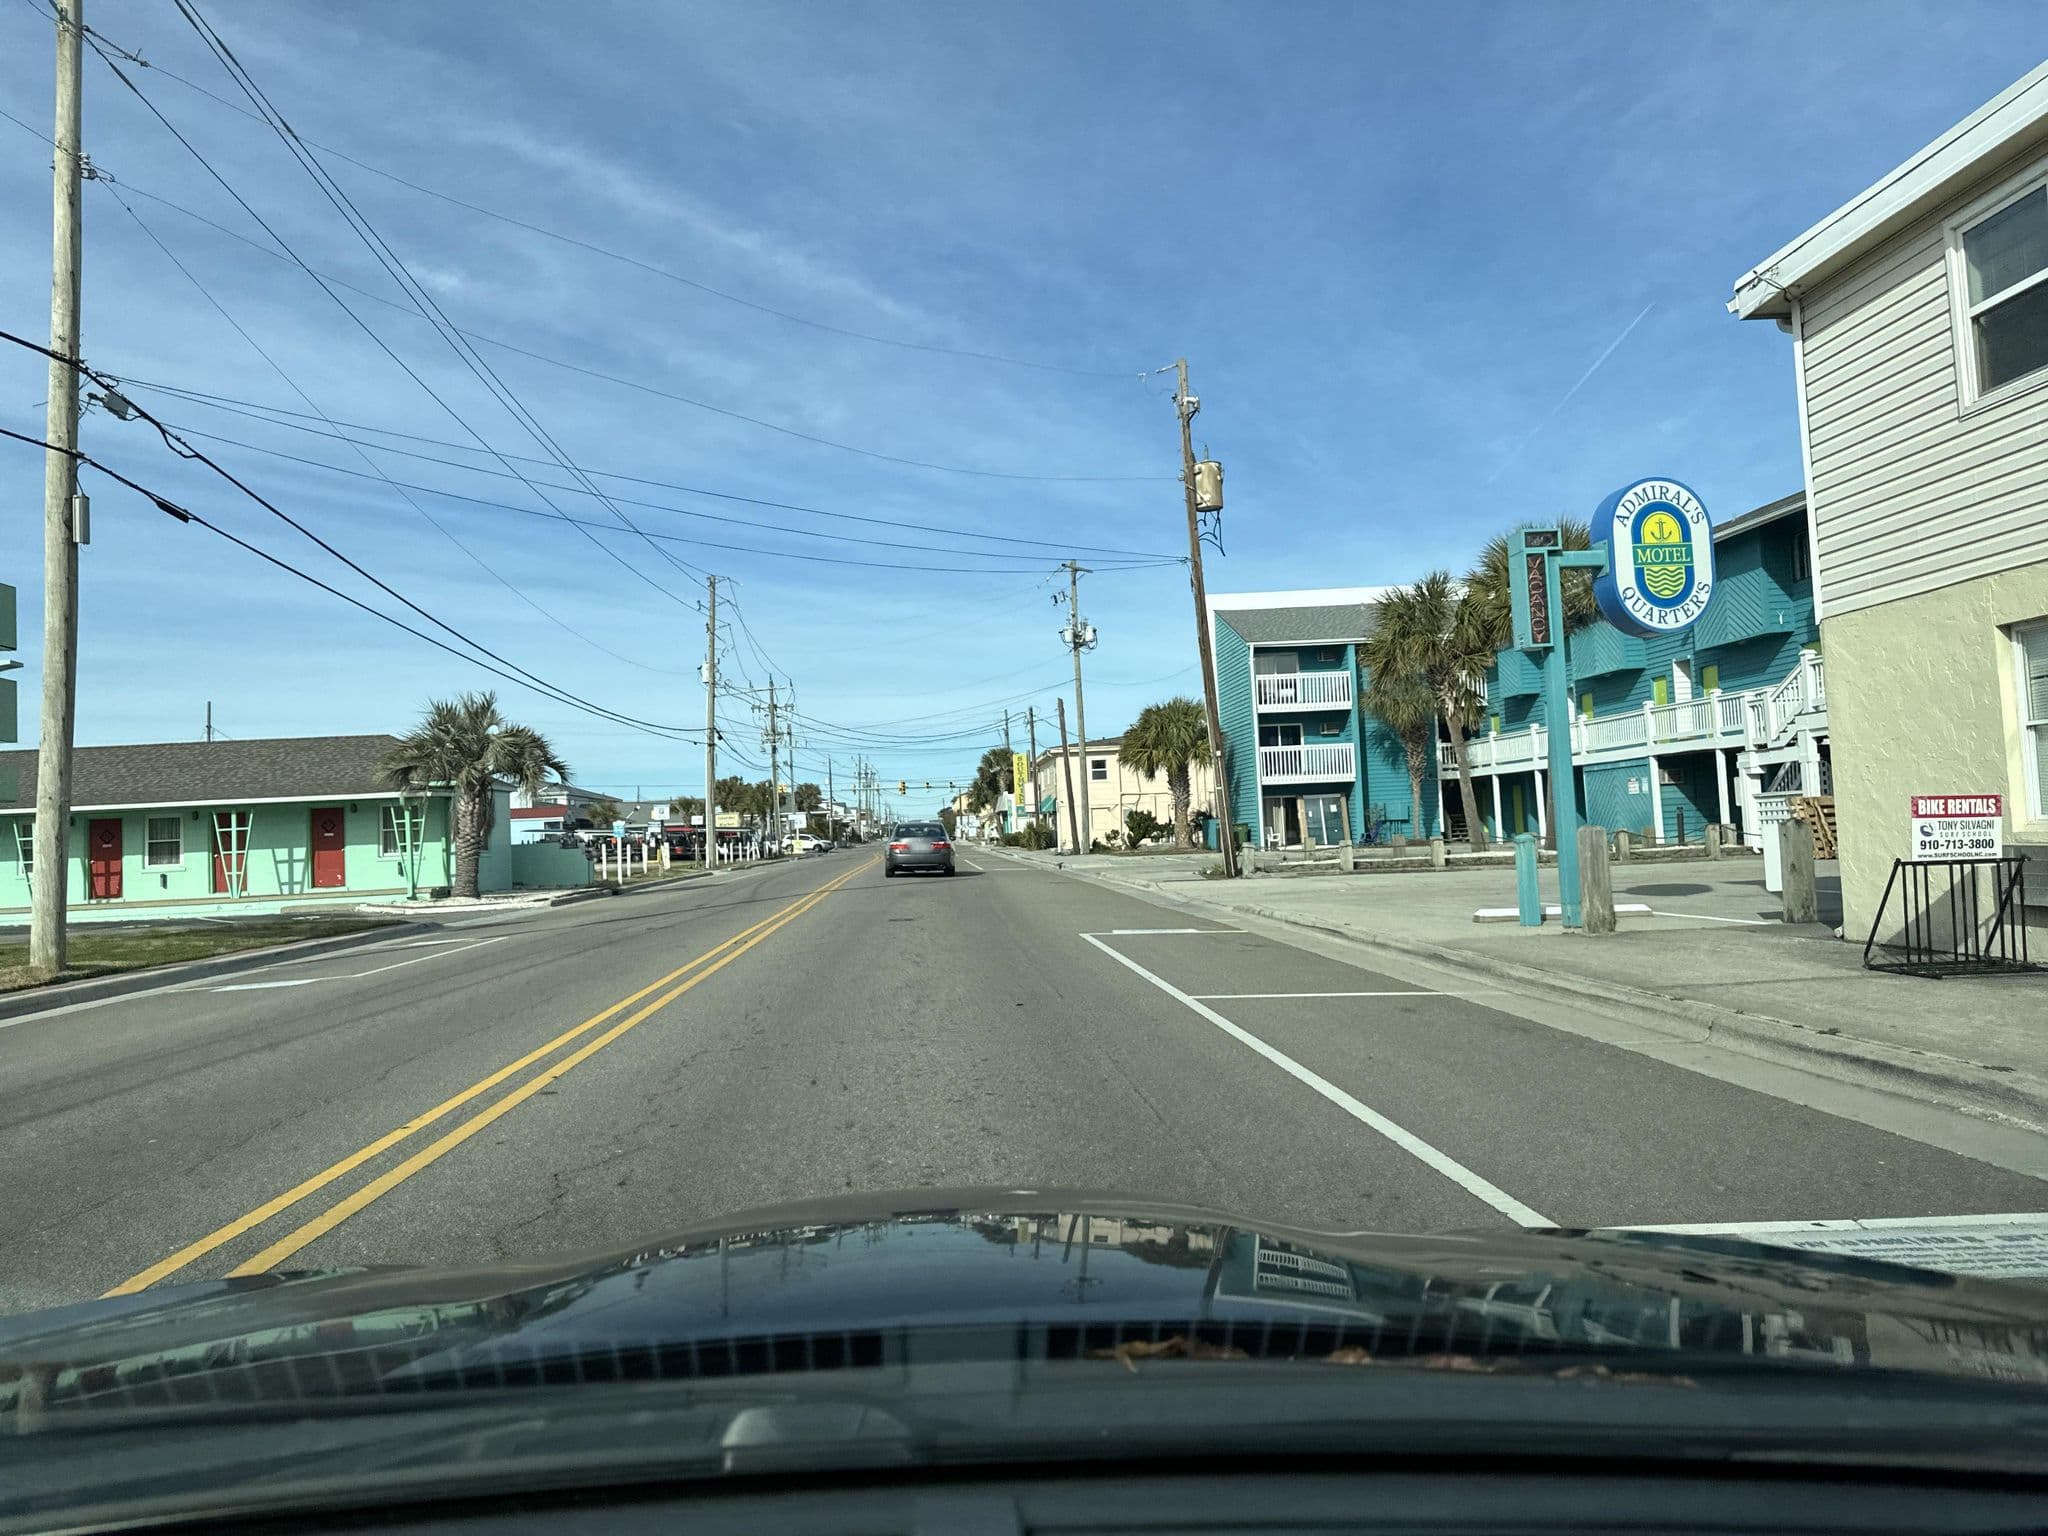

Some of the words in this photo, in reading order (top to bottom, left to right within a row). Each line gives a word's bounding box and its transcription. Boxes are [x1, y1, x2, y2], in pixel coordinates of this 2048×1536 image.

[1615, 485, 1704, 527] ADMIRAL'S
[1637, 547, 1690, 565] MOTEL
[1527, 557, 1546, 643] VACANCY
[1622, 581, 1711, 625] QUARTER'S
[1918, 799, 1945, 815] BIKE
[1947, 798, 1996, 814] RENTALS
[1937, 820, 1958, 831] TONY
[1960, 819, 1995, 830] SILVAGNI
[1920, 838, 1994, 850] 910-713-3800
